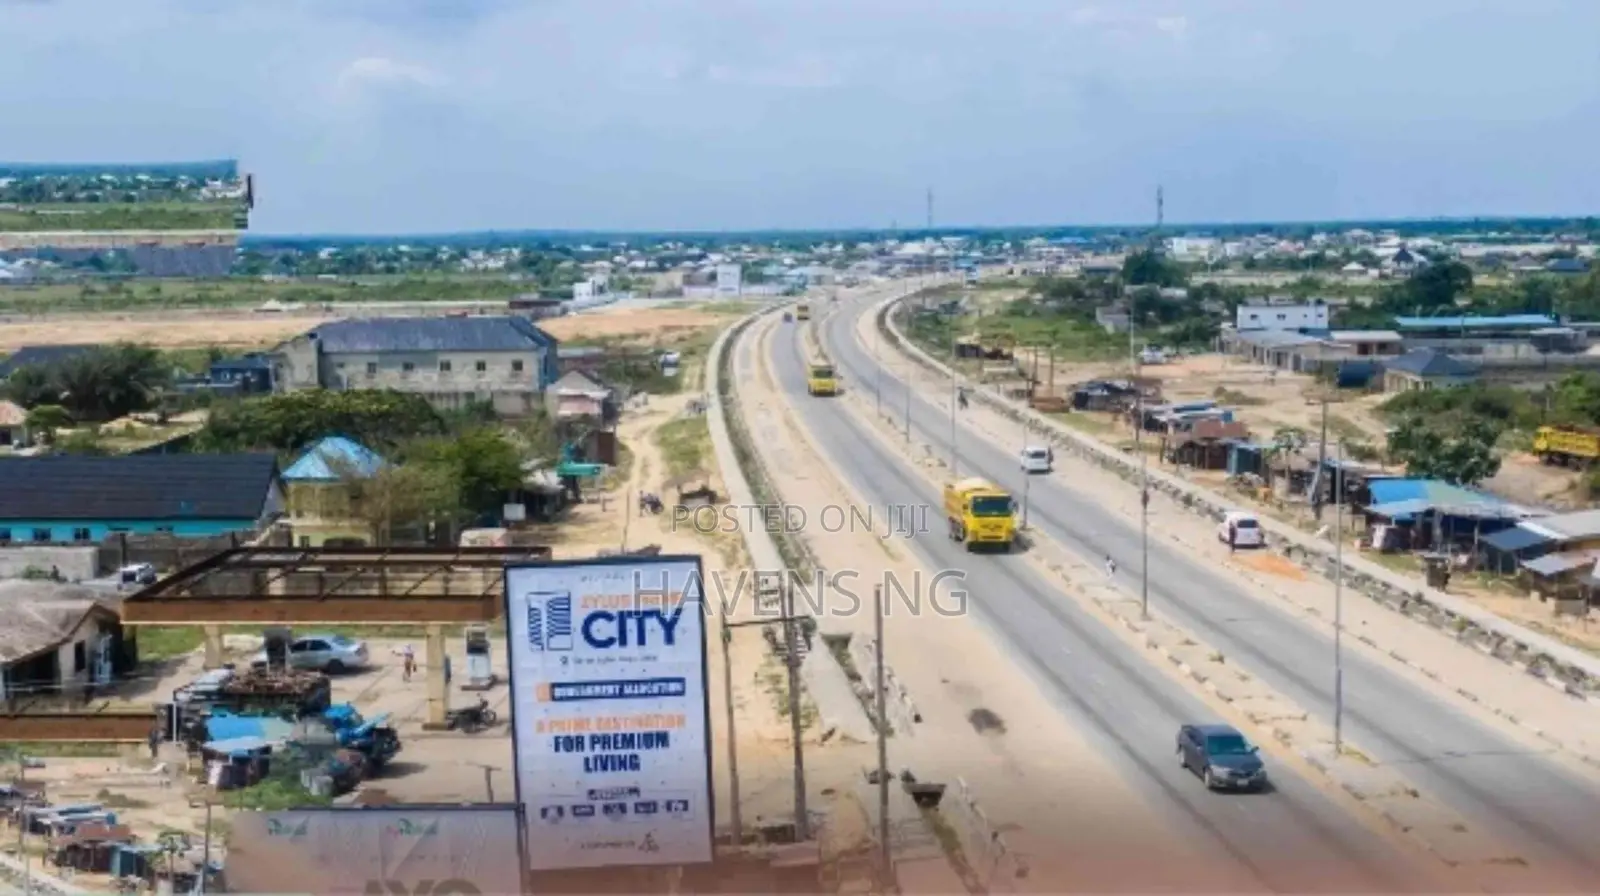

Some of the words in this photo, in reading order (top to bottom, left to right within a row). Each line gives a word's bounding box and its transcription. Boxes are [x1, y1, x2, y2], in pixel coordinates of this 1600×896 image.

[581, 608, 684, 649] CITY
[554, 734, 585, 753] FOR
[590, 731, 670, 752] PREMIUM
[583, 753, 641, 773] LIVING
